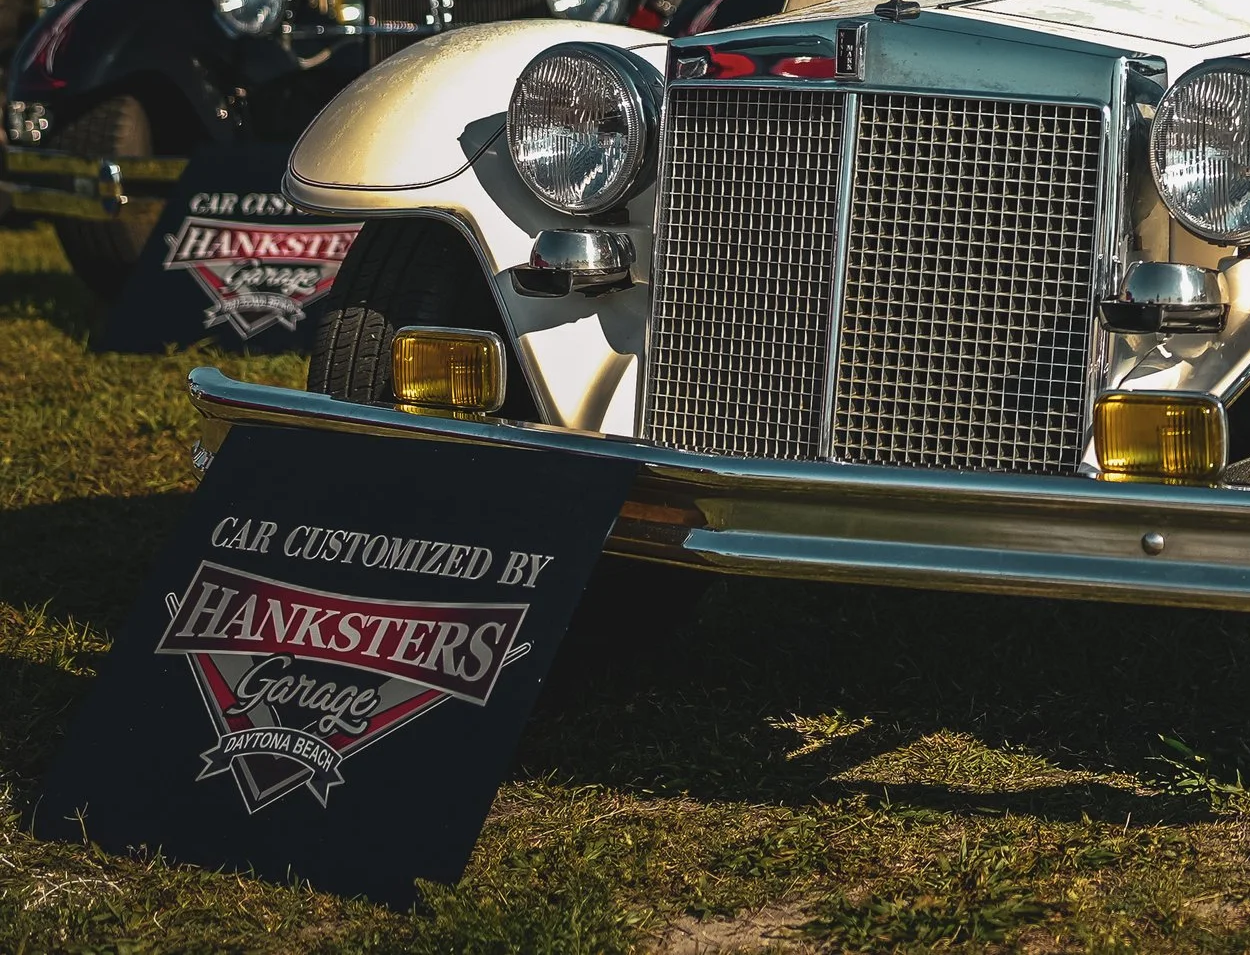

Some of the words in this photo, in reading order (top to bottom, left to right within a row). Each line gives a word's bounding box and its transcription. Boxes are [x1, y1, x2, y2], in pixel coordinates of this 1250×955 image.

[189, 193, 239, 216] CAR
[175, 226, 356, 259] HANKSTE
[219, 258, 322, 294] Garage
[211, 516, 277, 554] CAR
[284, 525, 493, 581] CUSTOMIZED
[497, 551, 555, 589] BY
[175, 581, 505, 682] HANKSTERS
[226, 654, 379, 734] Garage
[223, 731, 291, 755] DAYTONA
[292, 735, 335, 772] BEACH
